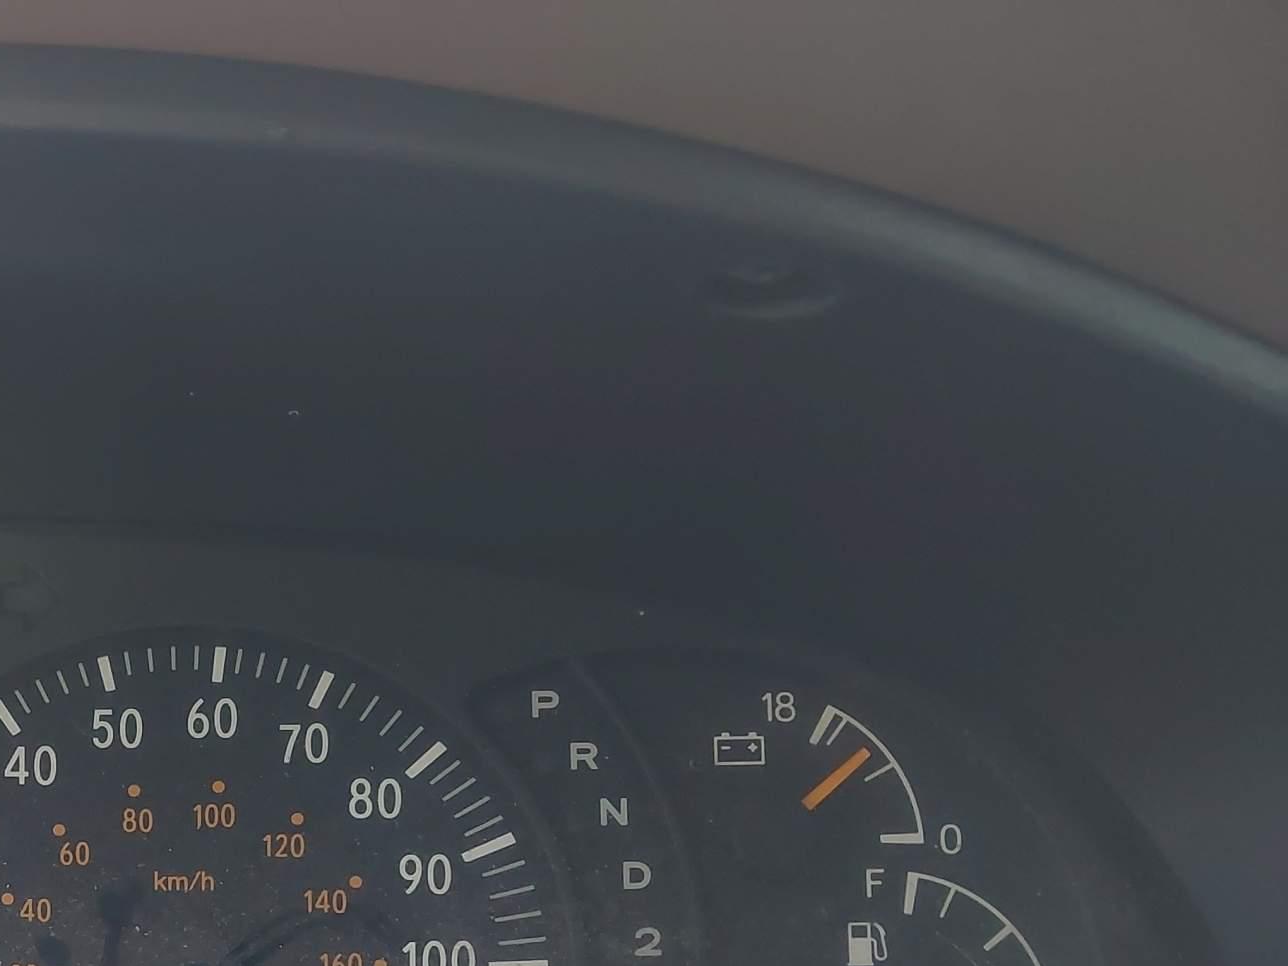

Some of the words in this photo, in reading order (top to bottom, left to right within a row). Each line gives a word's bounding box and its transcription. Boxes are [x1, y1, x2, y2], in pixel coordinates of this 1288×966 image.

[187, 698, 239, 739] 60
[532, 691, 560, 718] P
[761, 692, 796, 722] 18
[92, 708, 144, 749] 50
[279, 723, 330, 764] 70
[570, 743, 599, 770] R
[4, 745, 57, 786] 40
[349, 778, 402, 819] 80
[600, 798, 628, 826] N
[122, 808, 153, 833] 80
[193, 804, 235, 829] 100
[59, 841, 90, 865] 60
[264, 834, 305, 858] 120
[939, 824, 962, 854] 0
[153, 871, 215, 892] km/h
[398, 854, 452, 895] 90
[623, 861, 651, 889] D
[866, 869, 884, 898] F
[19, 898, 51, 922] 40
[304, 890, 347, 914] 140
[634, 928, 662, 956] 2
